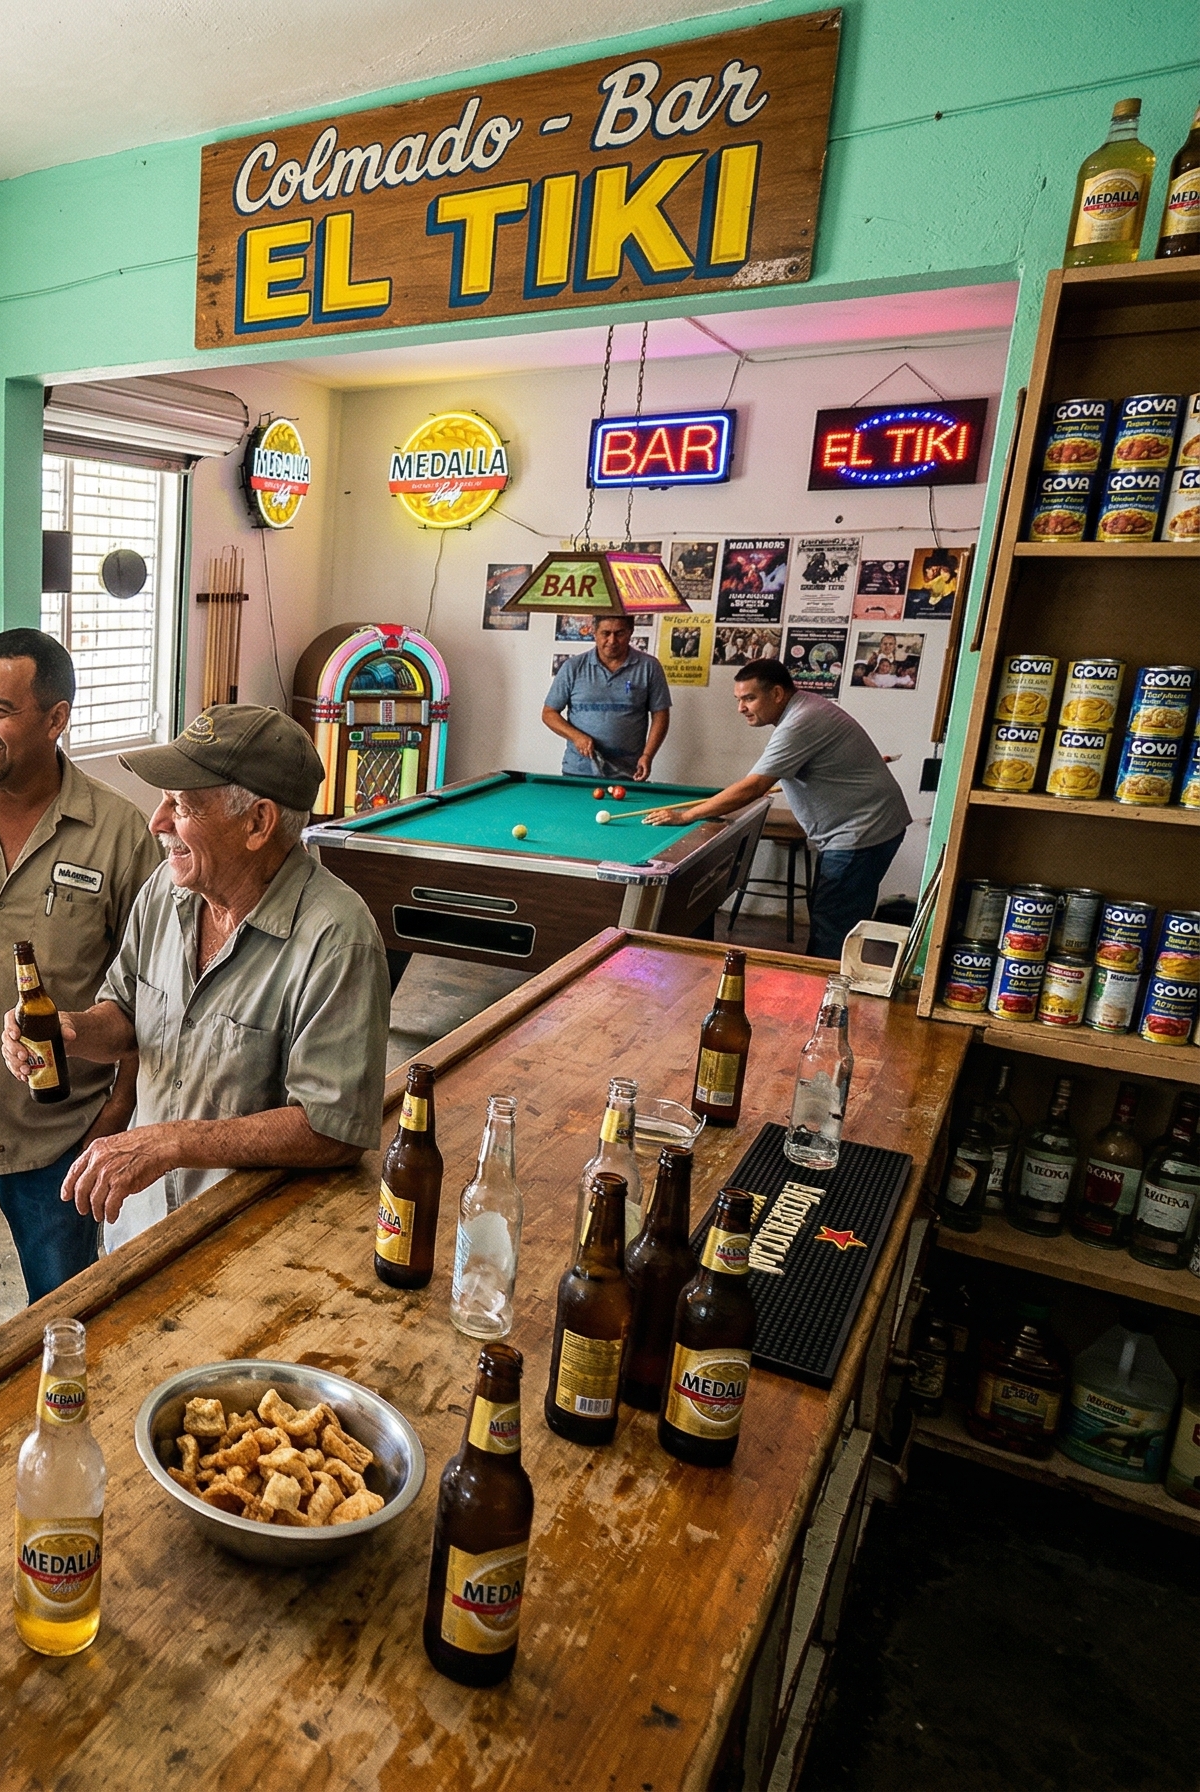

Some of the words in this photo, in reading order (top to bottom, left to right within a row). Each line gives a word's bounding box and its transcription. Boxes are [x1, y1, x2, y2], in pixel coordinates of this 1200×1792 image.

[236, 97, 521, 214] Colmado
[595, 59, 768, 149] Bar
[1083, 190, 1139, 207] MEDALLA
[236, 211, 392, 333] EL
[428, 141, 763, 306] TIKI
[602, 424, 718, 476] BAR
[823, 432, 873, 467] EL
[885, 424, 968, 463] TIKI
[390, 449, 506, 480] MEDALLA
[541, 574, 597, 598] BAR
[22, 1543, 100, 1574] MEDALLA
